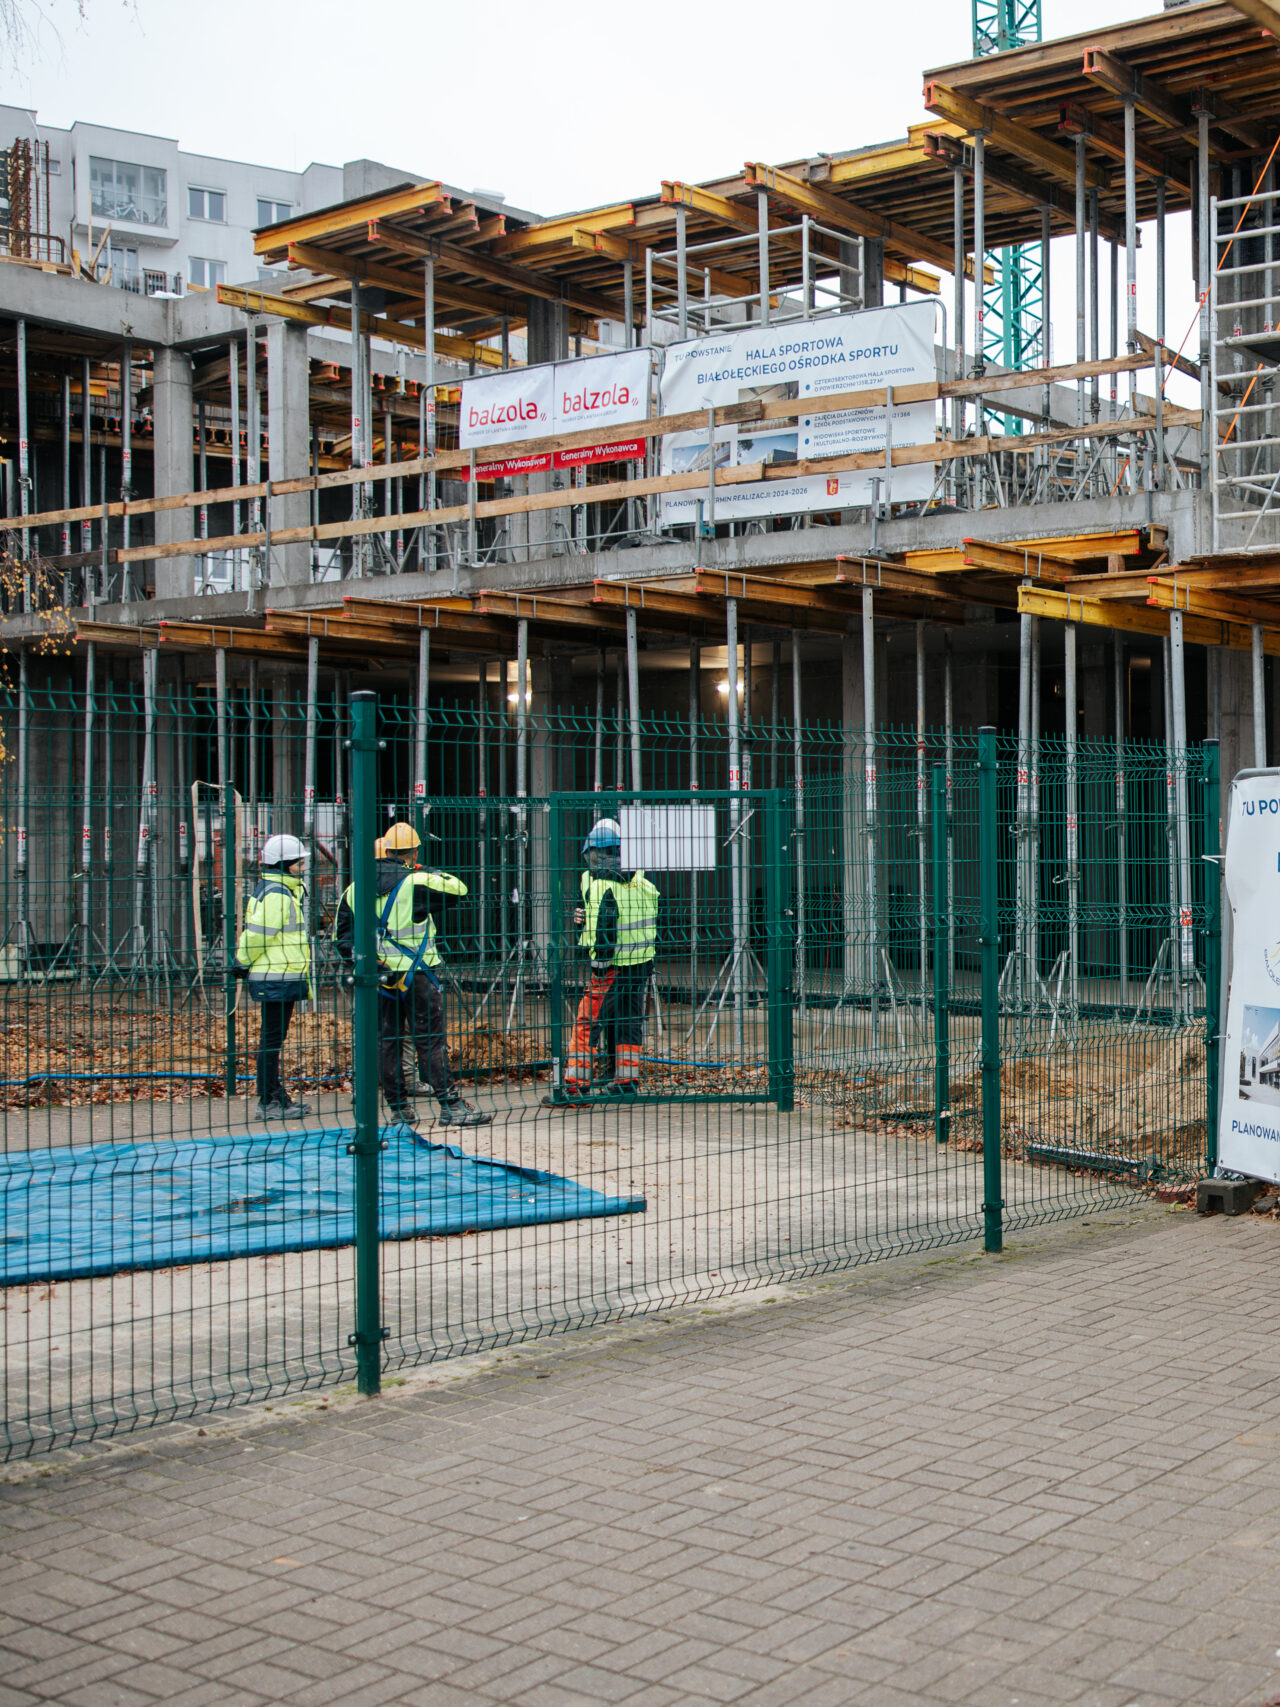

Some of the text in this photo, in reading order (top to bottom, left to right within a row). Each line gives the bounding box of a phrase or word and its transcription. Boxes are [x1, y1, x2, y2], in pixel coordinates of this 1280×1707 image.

[685, 344, 732, 360] POWSTANIE
[746, 336, 844, 361] HALA SPORTOWA
[697, 344, 899, 385] BIAŁOŁĘCKIEGO OŚRODKA SPORTU
[563, 383, 629, 414] balzola
[468, 398, 538, 428] balzola
[561, 443, 638, 461] Generalny Wykonawca
[473, 461, 505, 473] eneralny
[772, 487, 809, 498] 2024-2026
[1242, 800, 1255, 816] TU
